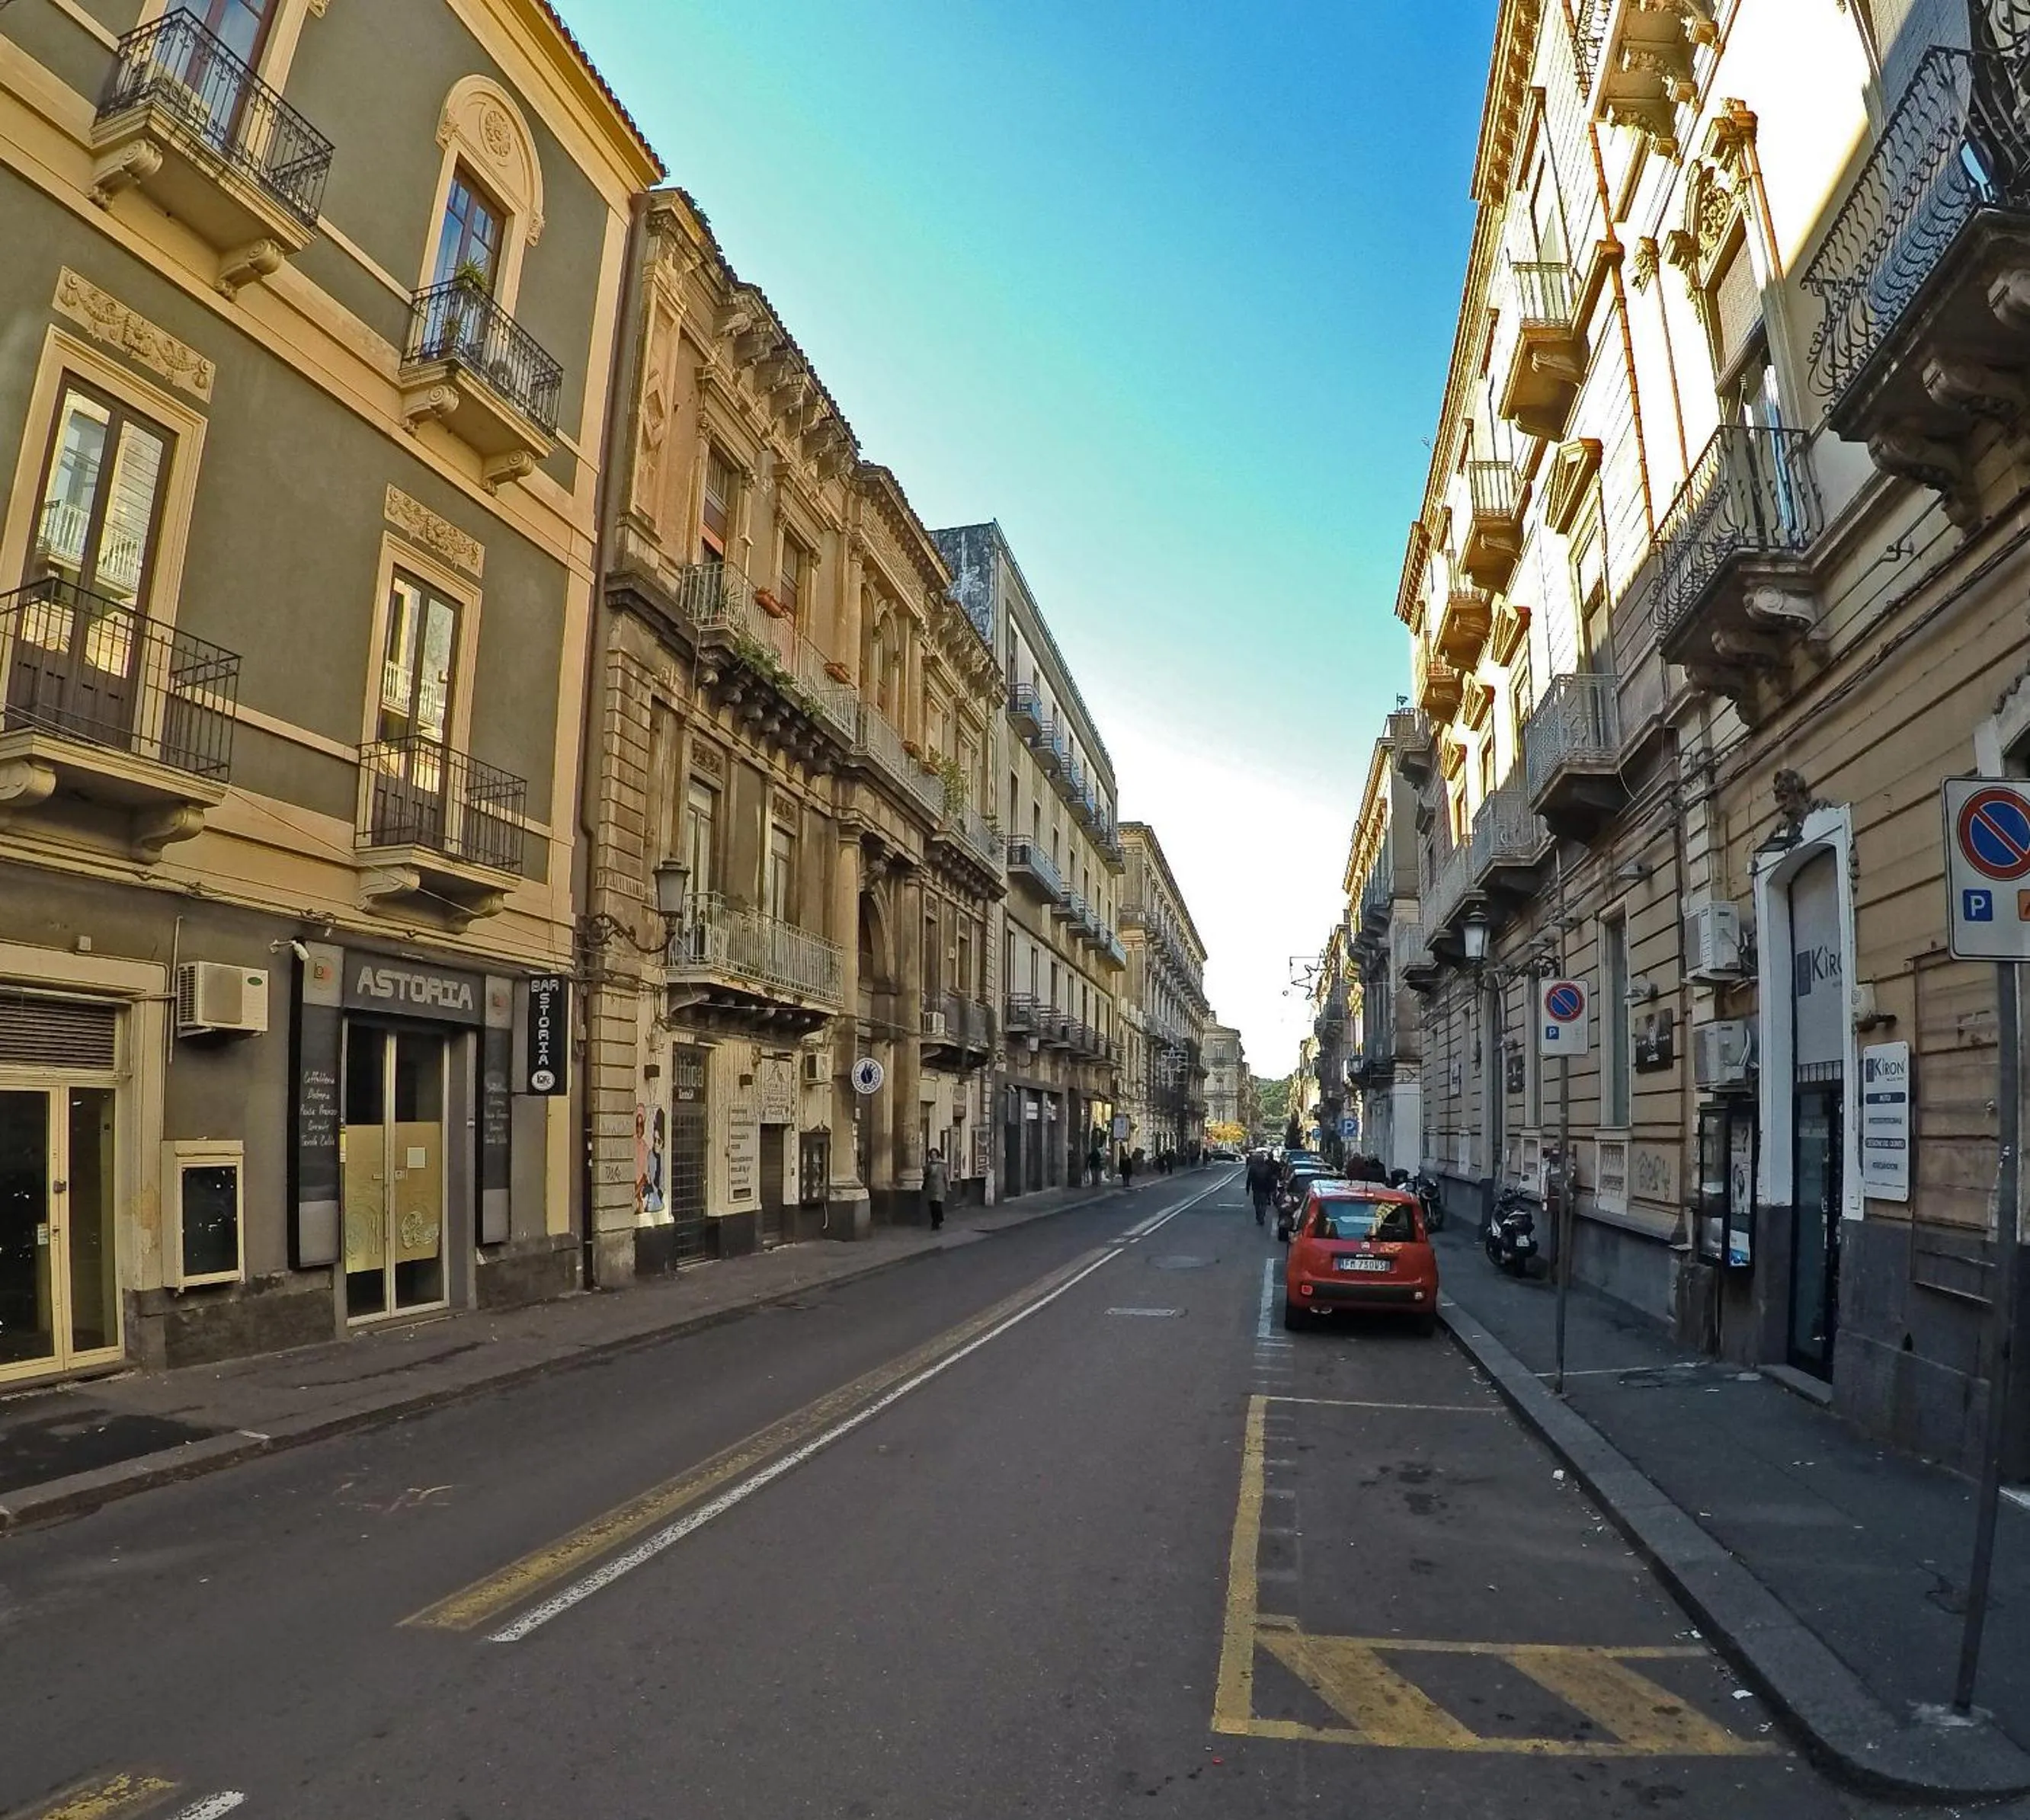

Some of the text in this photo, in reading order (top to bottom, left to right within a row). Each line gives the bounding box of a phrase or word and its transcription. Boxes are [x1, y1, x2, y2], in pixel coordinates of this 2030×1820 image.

[1970, 895, 1986, 916] P
[357, 965, 473, 1011] ASTORIA
[530, 979, 559, 993] BAR
